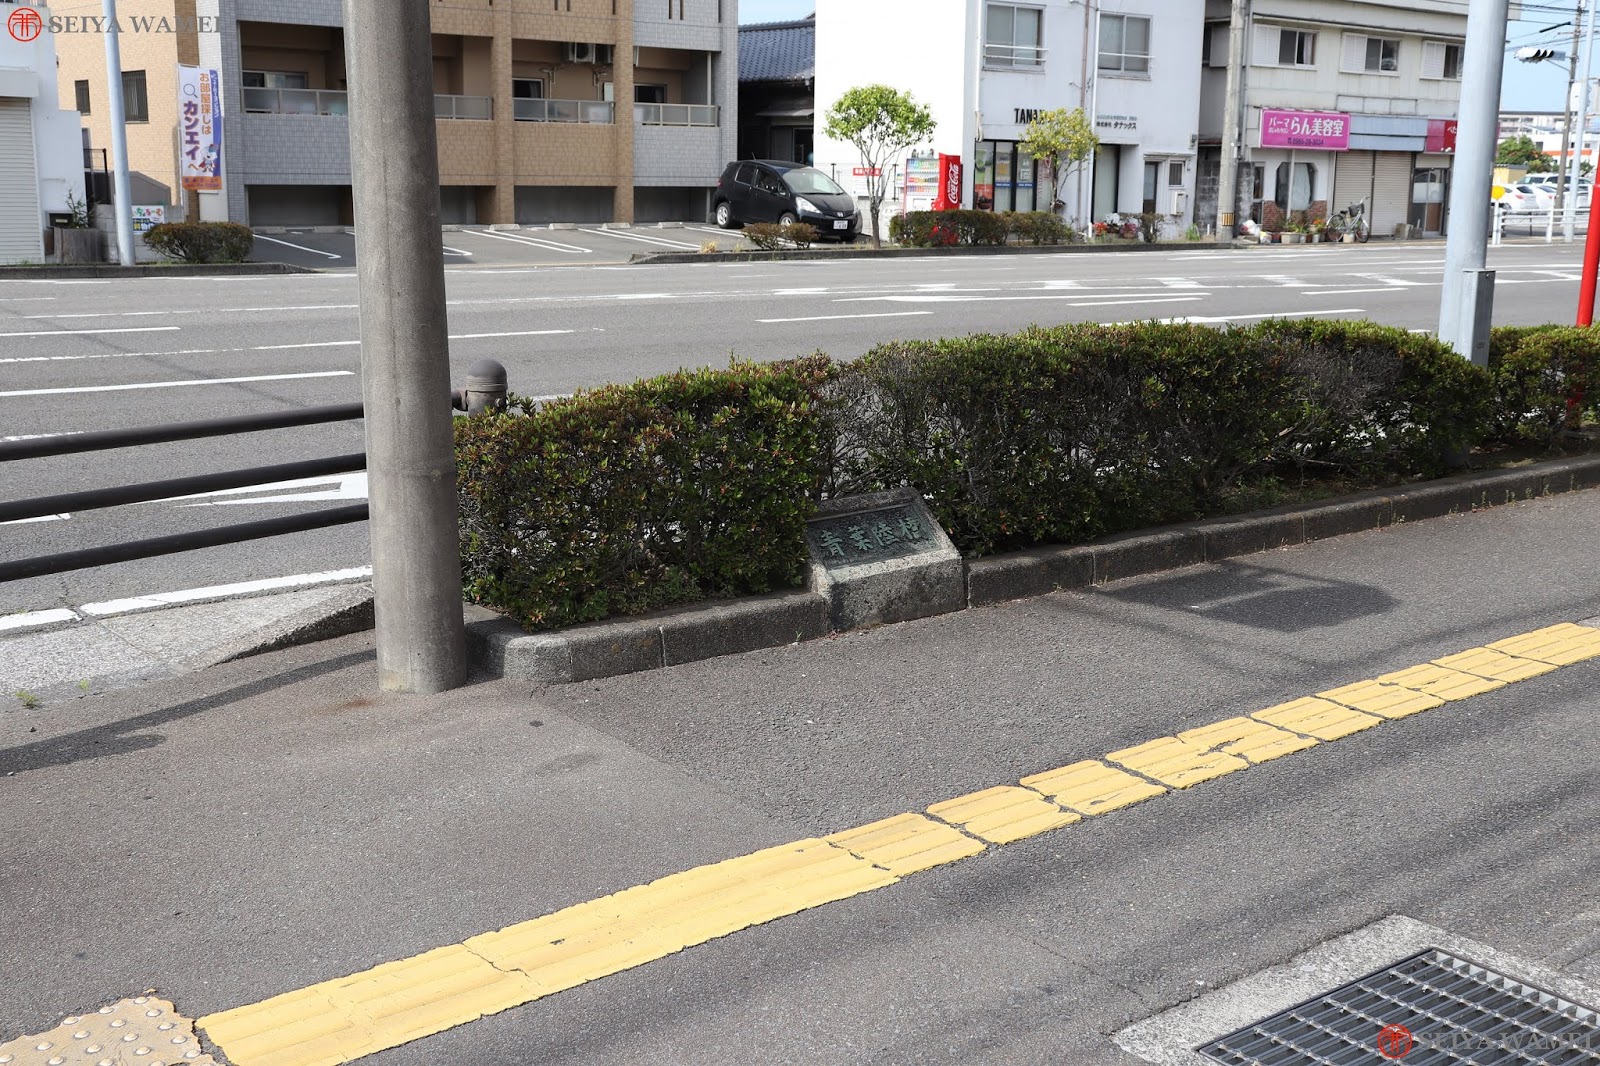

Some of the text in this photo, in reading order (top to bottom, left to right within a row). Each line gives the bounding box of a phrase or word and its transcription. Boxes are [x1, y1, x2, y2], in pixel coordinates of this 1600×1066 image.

[200, 72, 212, 135] お部屋探しは
[1114, 121, 1137, 130] タナックス
[1269, 116, 1290, 128] パーマ
[1291, 116, 1344, 137] らん美容室
[820, 516, 922, 557] 青葉陸橋
